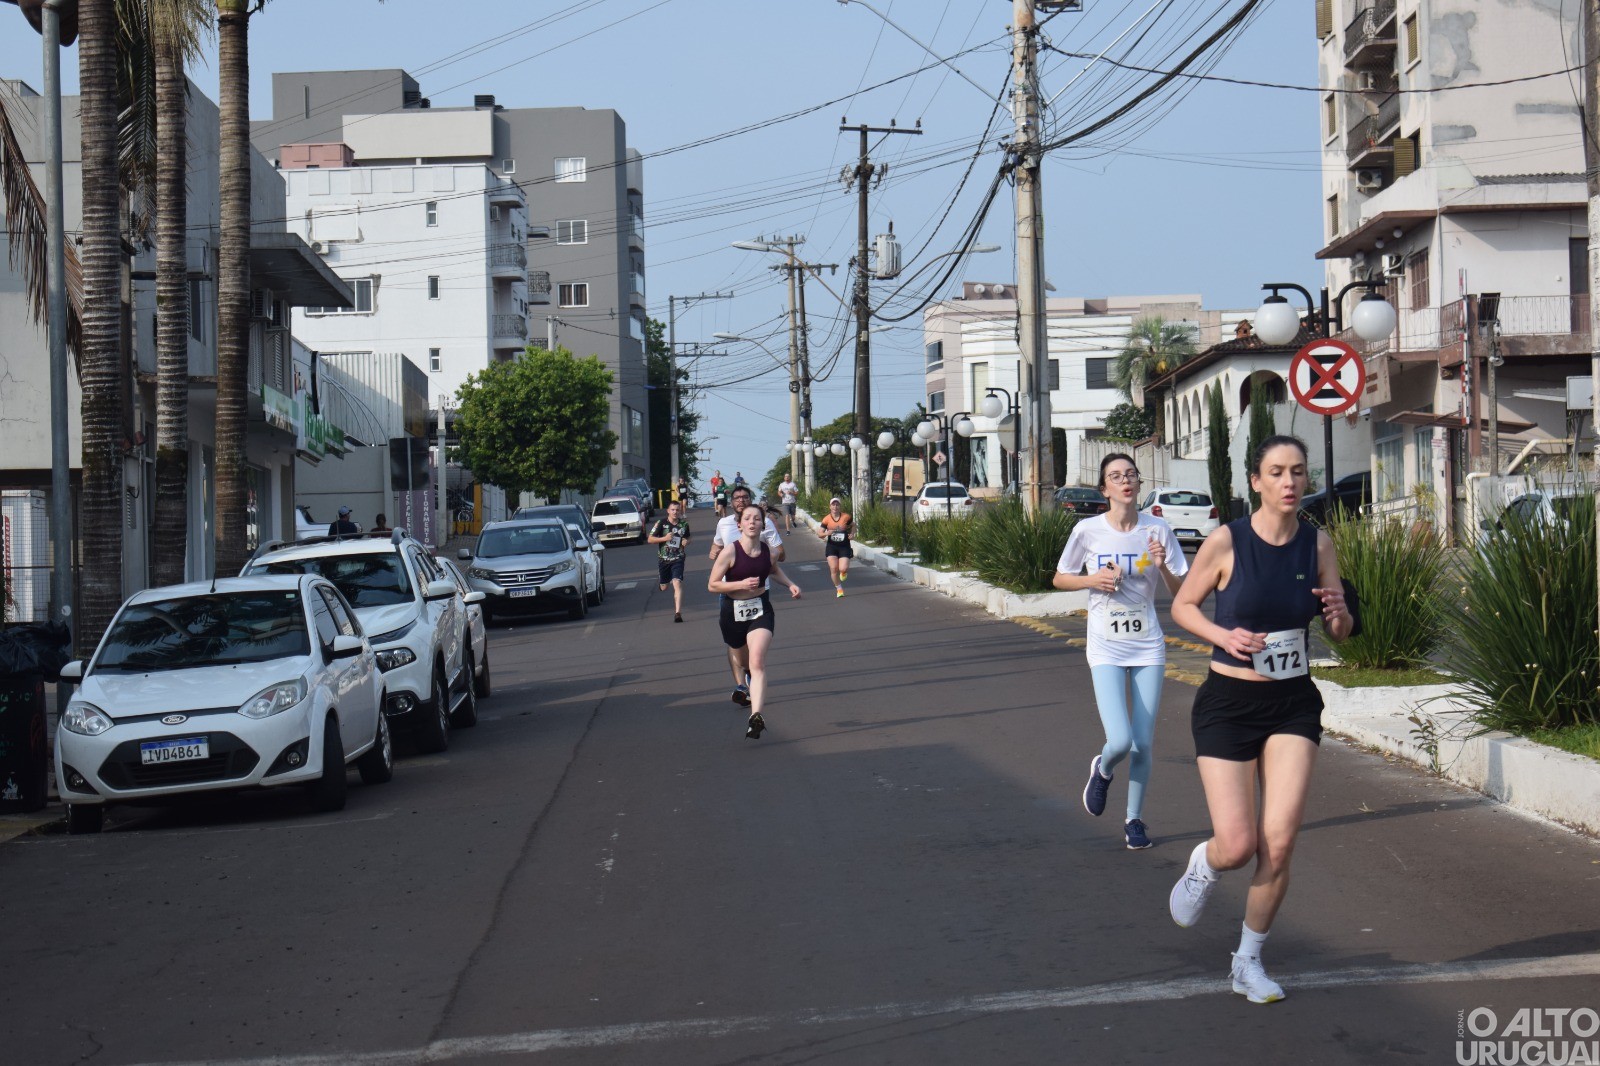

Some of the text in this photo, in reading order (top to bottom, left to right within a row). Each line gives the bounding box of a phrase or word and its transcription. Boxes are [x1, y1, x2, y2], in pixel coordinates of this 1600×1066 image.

[739, 607, 758, 618] 129
[1111, 619, 1142, 634] 119
[1263, 650, 1301, 673] 172
[148, 745, 202, 762] IVD4B61
